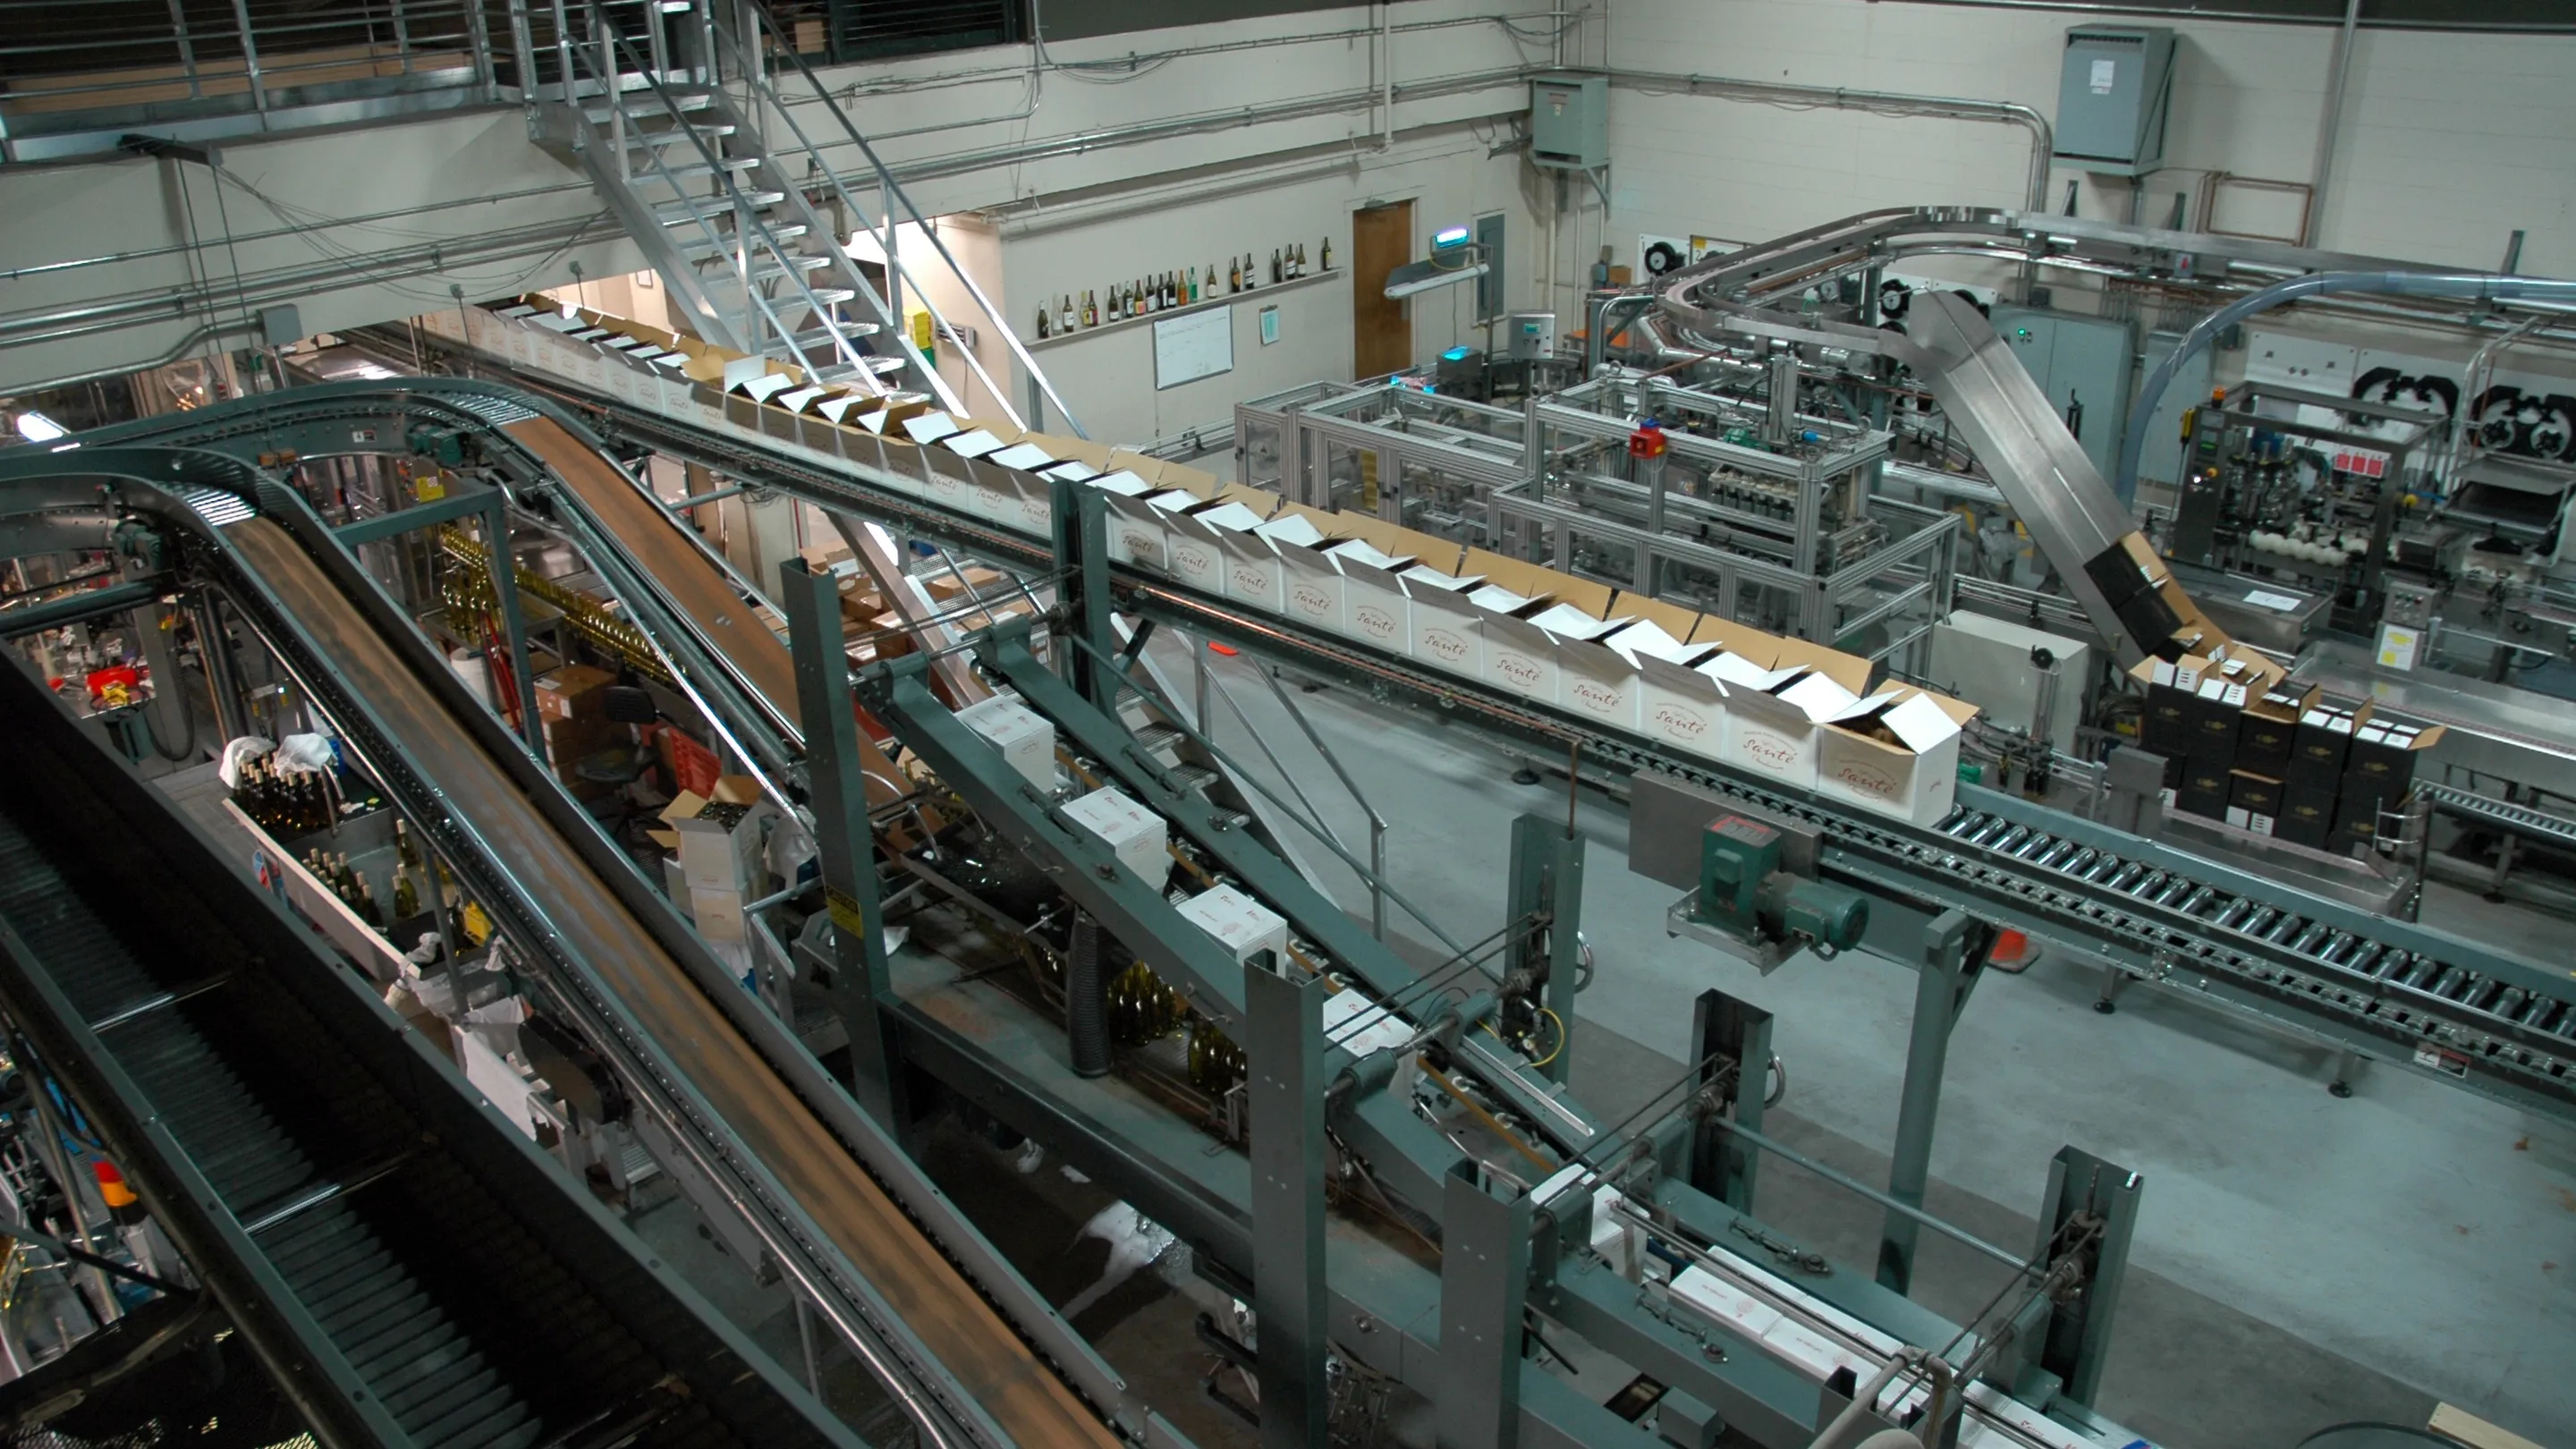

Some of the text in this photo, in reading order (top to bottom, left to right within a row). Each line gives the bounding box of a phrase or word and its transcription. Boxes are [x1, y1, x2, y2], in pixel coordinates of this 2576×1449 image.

[1695, 250, 1701, 261] 2
[1294, 590, 1332, 610] Santé
[1356, 612, 1396, 633] Santé
[1425, 635, 1469, 656] Santé
[1496, 659, 1543, 682] Santé
[1572, 683, 1623, 708] Santé
[1656, 710, 1707, 734] Santé
[1743, 739, 1800, 764] Santé
[1838, 767, 1898, 794] Santé
